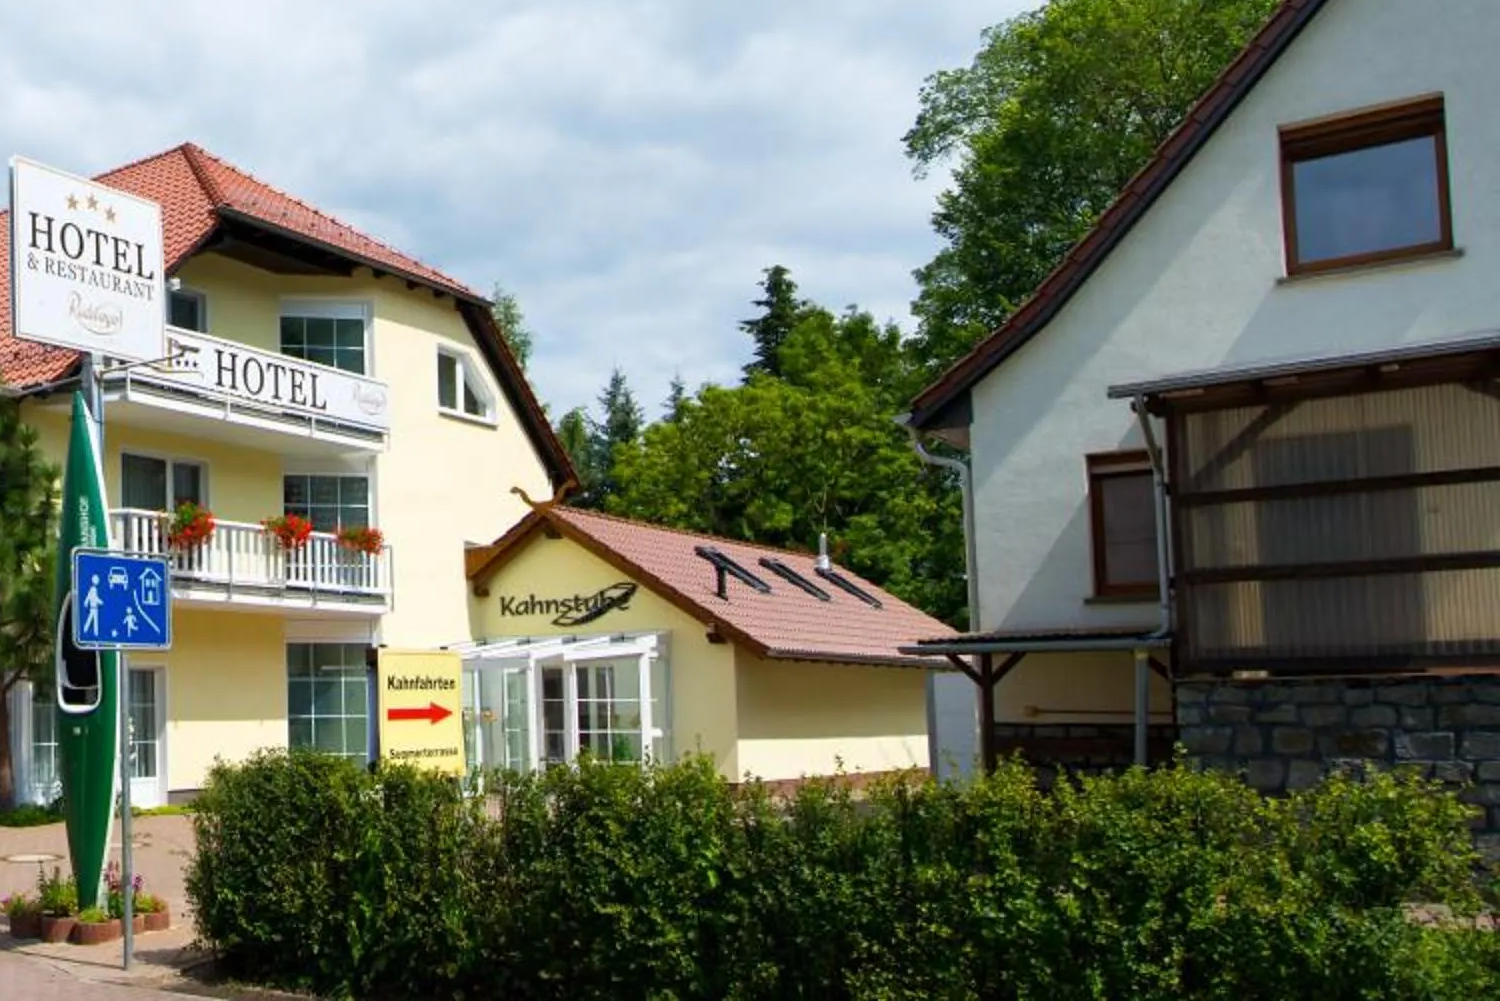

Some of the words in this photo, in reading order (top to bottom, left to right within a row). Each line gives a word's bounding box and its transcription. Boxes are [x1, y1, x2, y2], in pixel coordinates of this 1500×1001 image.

[28, 211, 155, 280] HOTEL
[27, 251, 39, 271] &
[45, 256, 155, 301] RESTAURANT
[214, 349, 327, 410] HOTEL
[387, 674, 456, 691] Kahnfahrten
